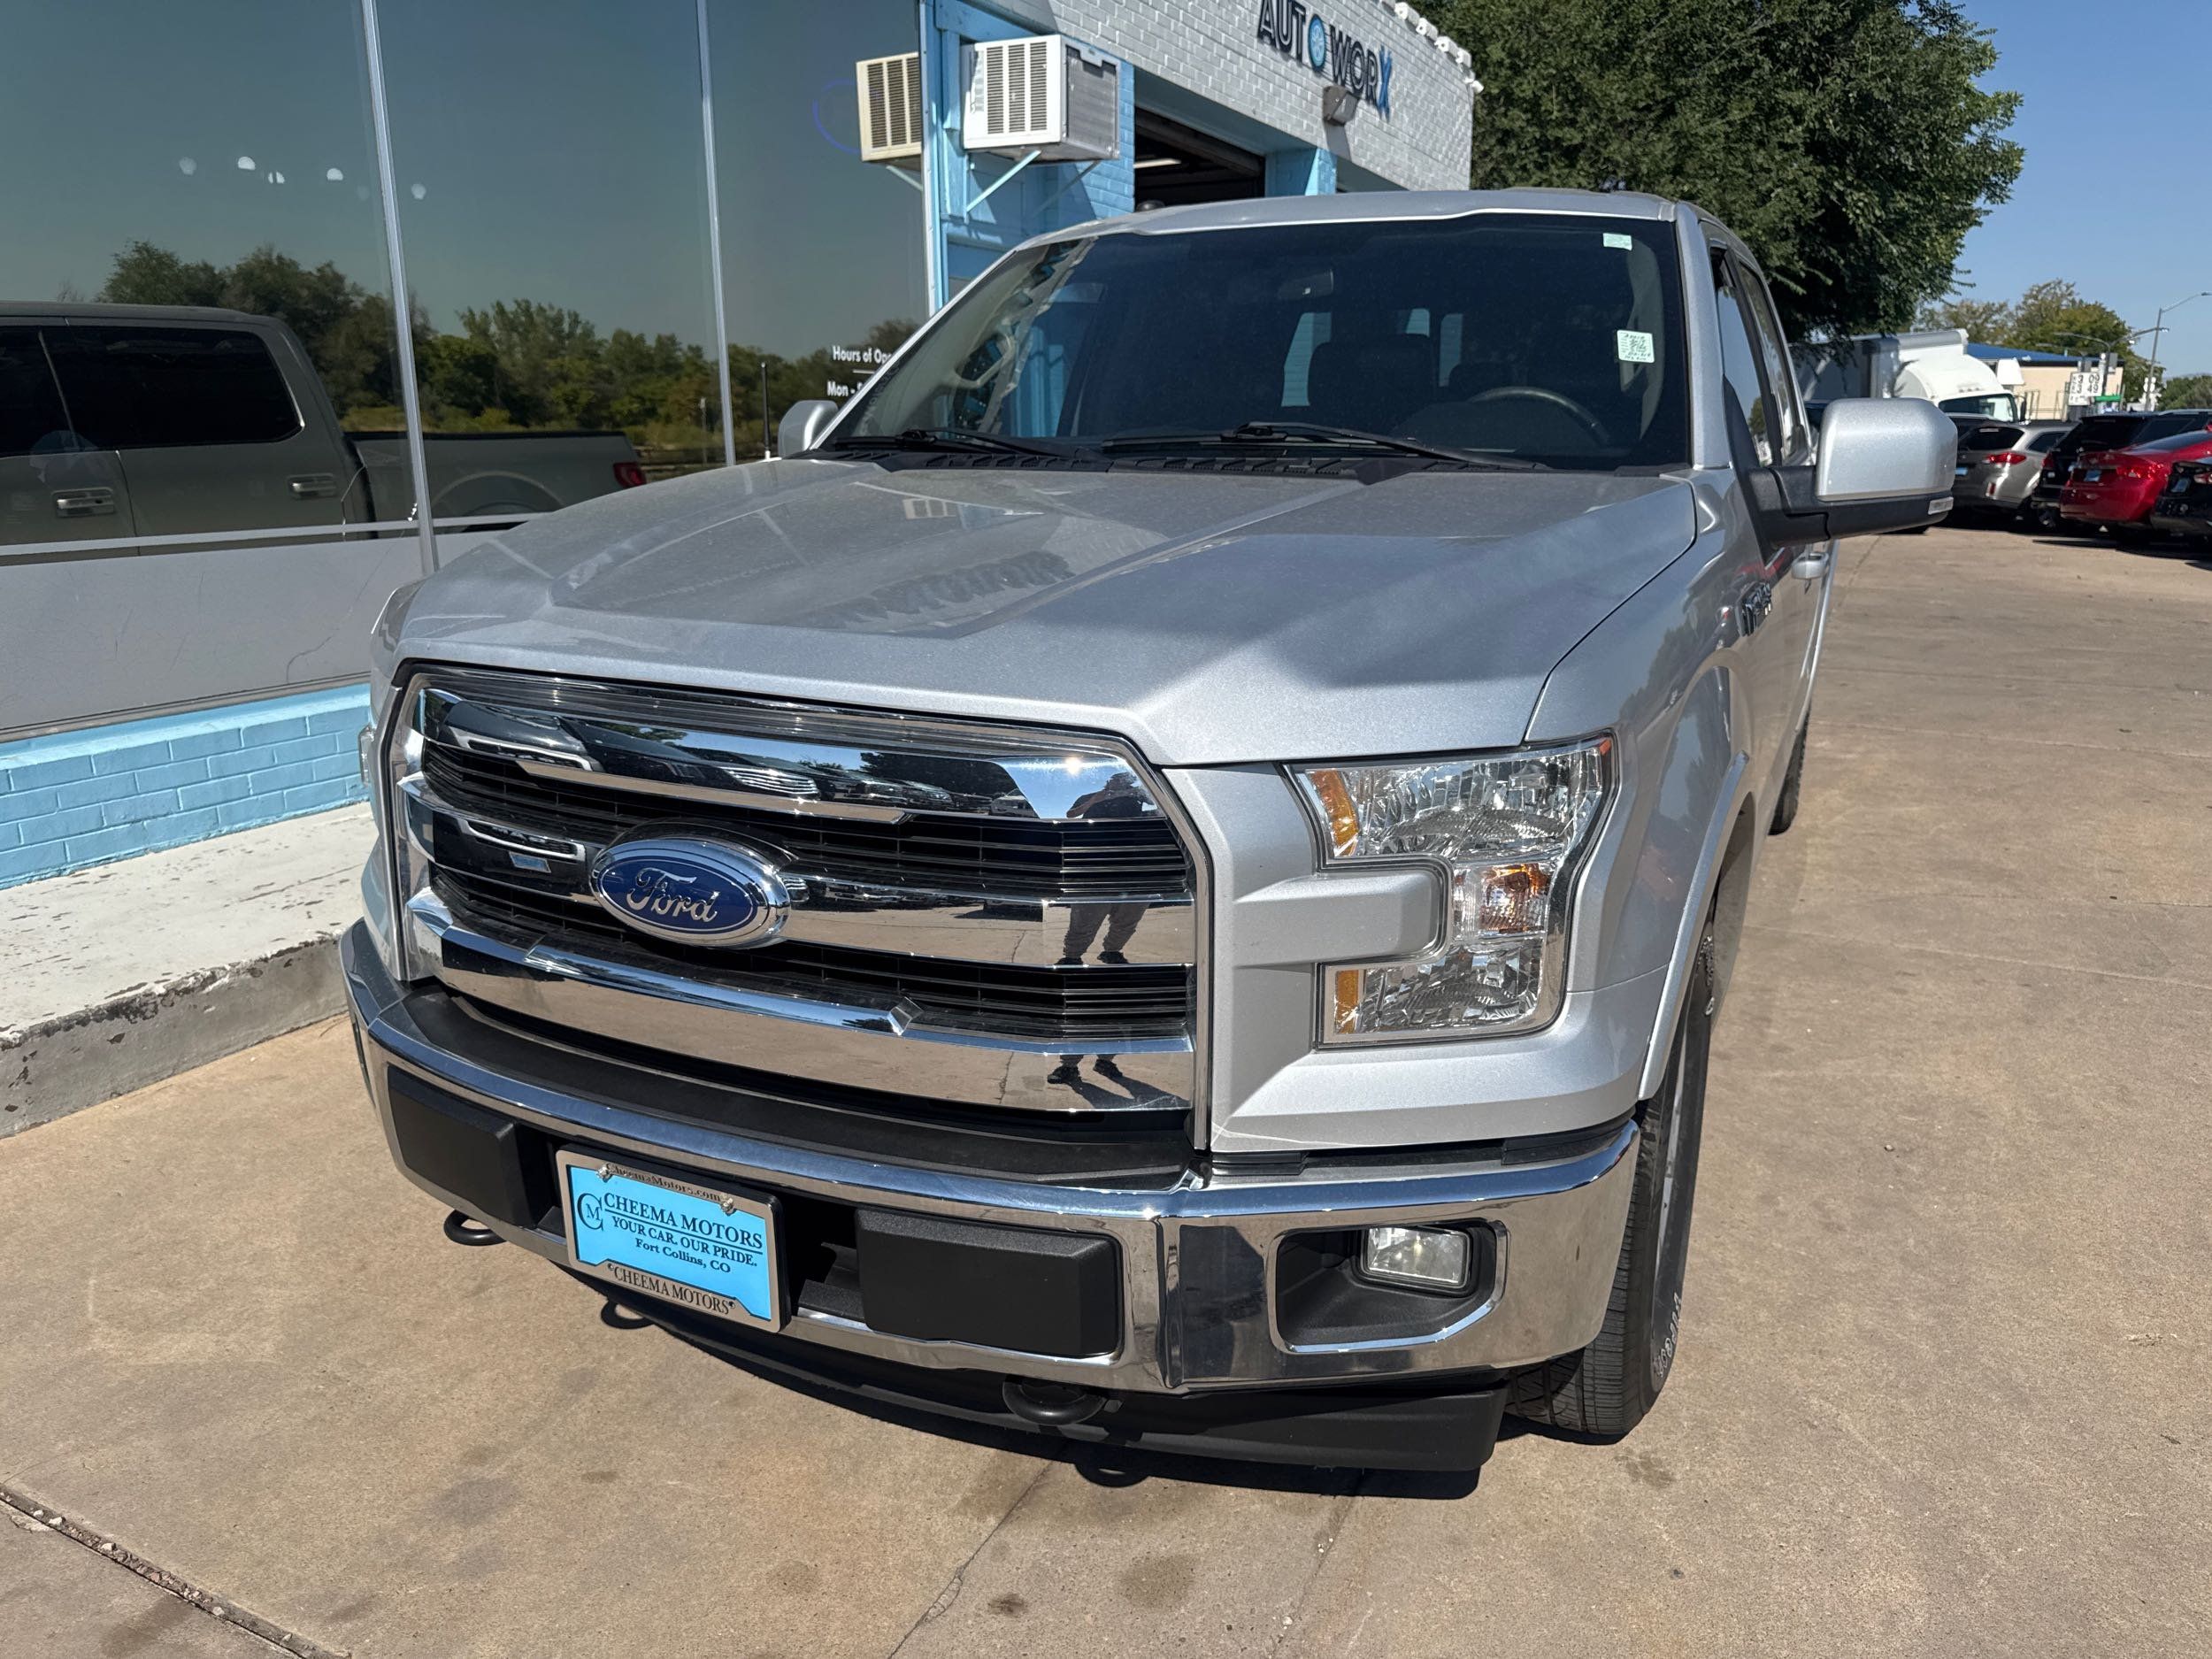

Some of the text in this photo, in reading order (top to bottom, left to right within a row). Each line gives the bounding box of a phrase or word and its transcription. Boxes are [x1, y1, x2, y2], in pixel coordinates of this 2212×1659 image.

[833, 345, 861, 363] Hours
[863, 347, 872, 363] of
[827, 380, 849, 397] Mon
[626, 867, 719, 922] Ford
[604, 1192, 763, 1249] CHEEMA MOTORS
[611, 1216, 646, 1236] YOUR
[680, 1237, 709, 1255] OUR
[713, 1246, 757, 1267] PRIDE.
[635, 1238, 731, 1273] Fort Collins, CO
[614, 1265, 729, 1315] CHEEMA MOTORS
